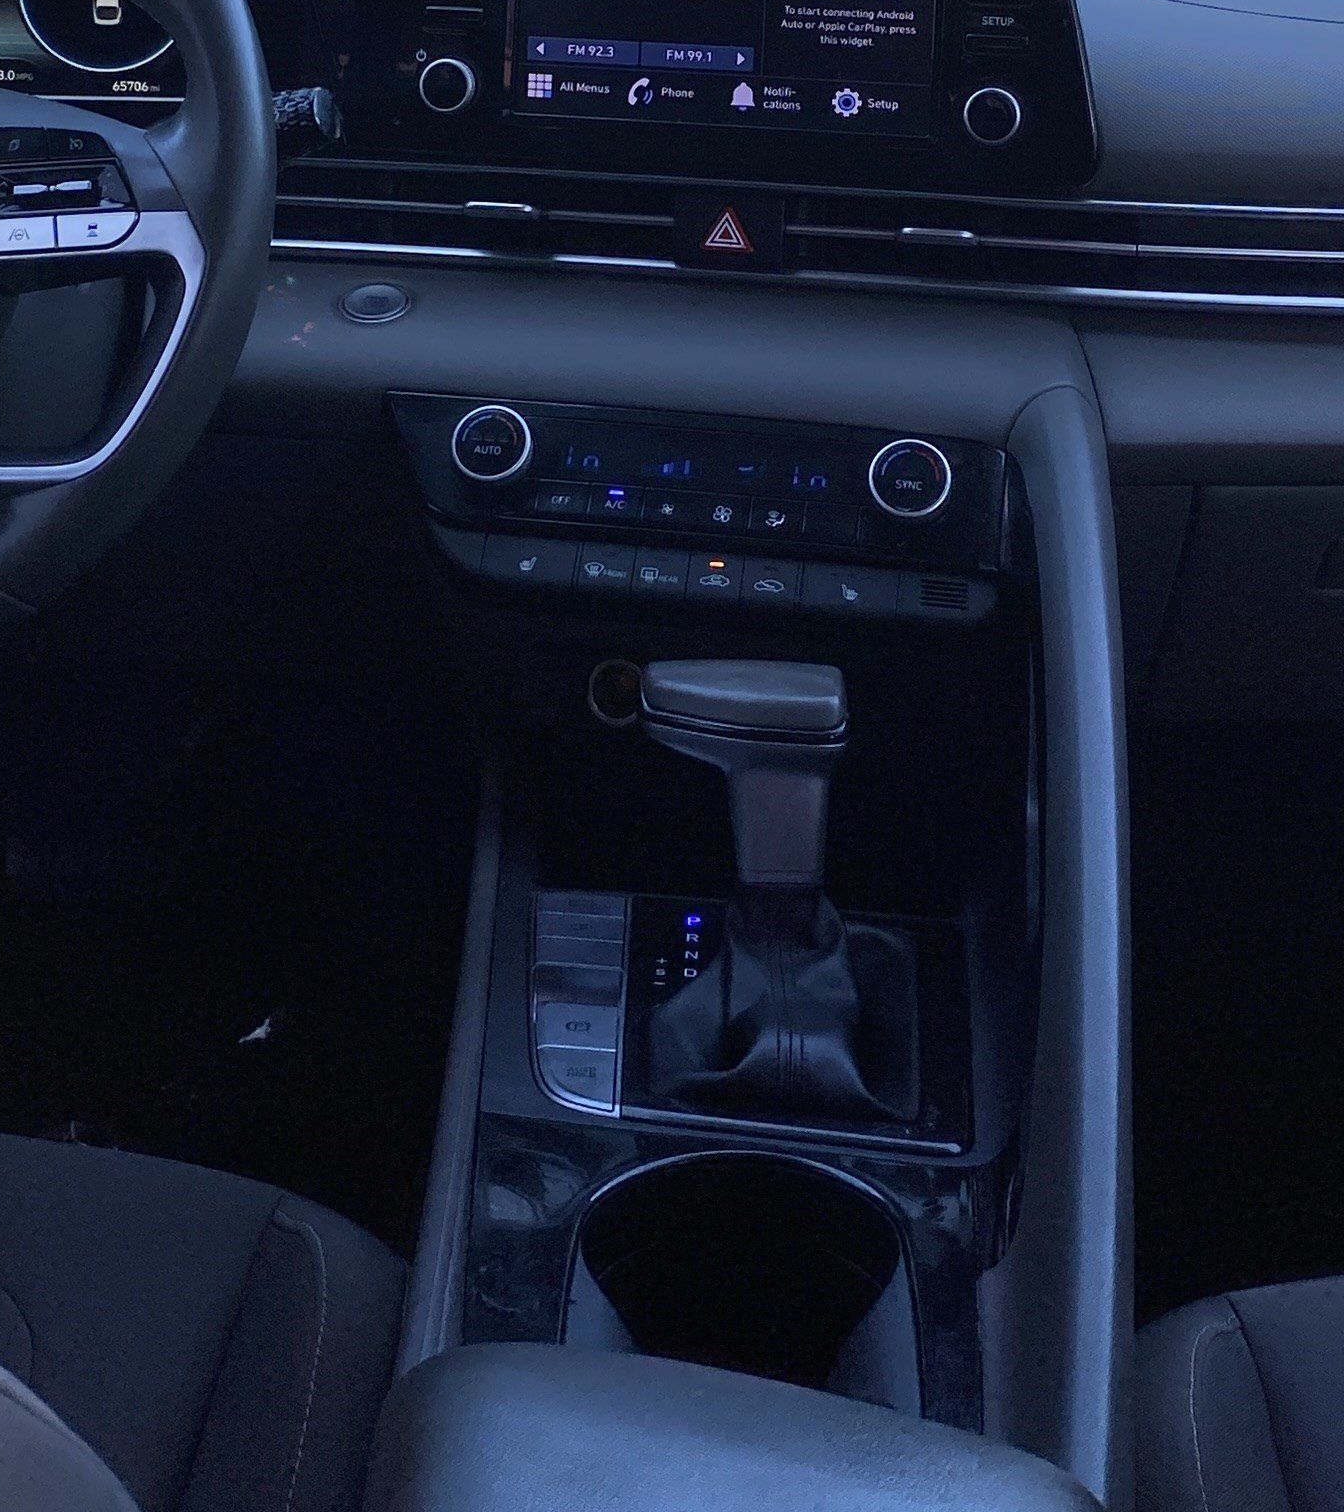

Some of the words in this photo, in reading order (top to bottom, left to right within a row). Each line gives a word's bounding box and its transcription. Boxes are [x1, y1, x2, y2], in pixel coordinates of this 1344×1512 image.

[784, 5, 795, 15] To
[797, 7, 820, 16] start
[823, 9, 874, 20] connecting
[876, 10, 914, 20] Android
[781, 19, 803, 29] Auto
[818, 21, 846, 32] Apple
[889, 26, 916, 35] press
[982, 16, 1014, 26] SETUP
[820, 35, 838, 44] this
[567, 45, 586, 56] FM
[588, 46, 614, 58] 92.3
[666, 50, 684, 61] FM
[688, 50, 712, 62] 99.1
[112, 80, 149, 92] 65706
[560, 82, 574, 92] All
[576, 83, 610, 94] Menus
[661, 87, 694, 99] Phone
[763, 86, 797, 99] Notifi-
[763, 99, 801, 111] cations
[867, 98, 899, 112] Setup
[474, 445, 502, 456] AUTO
[895, 479, 923, 491] SYNC
[605, 500, 625, 510] A/C
[687, 916, 701, 925] P
[685, 933, 699, 943] R
[684, 950, 699, 960] N
[683, 968, 697, 978] D
